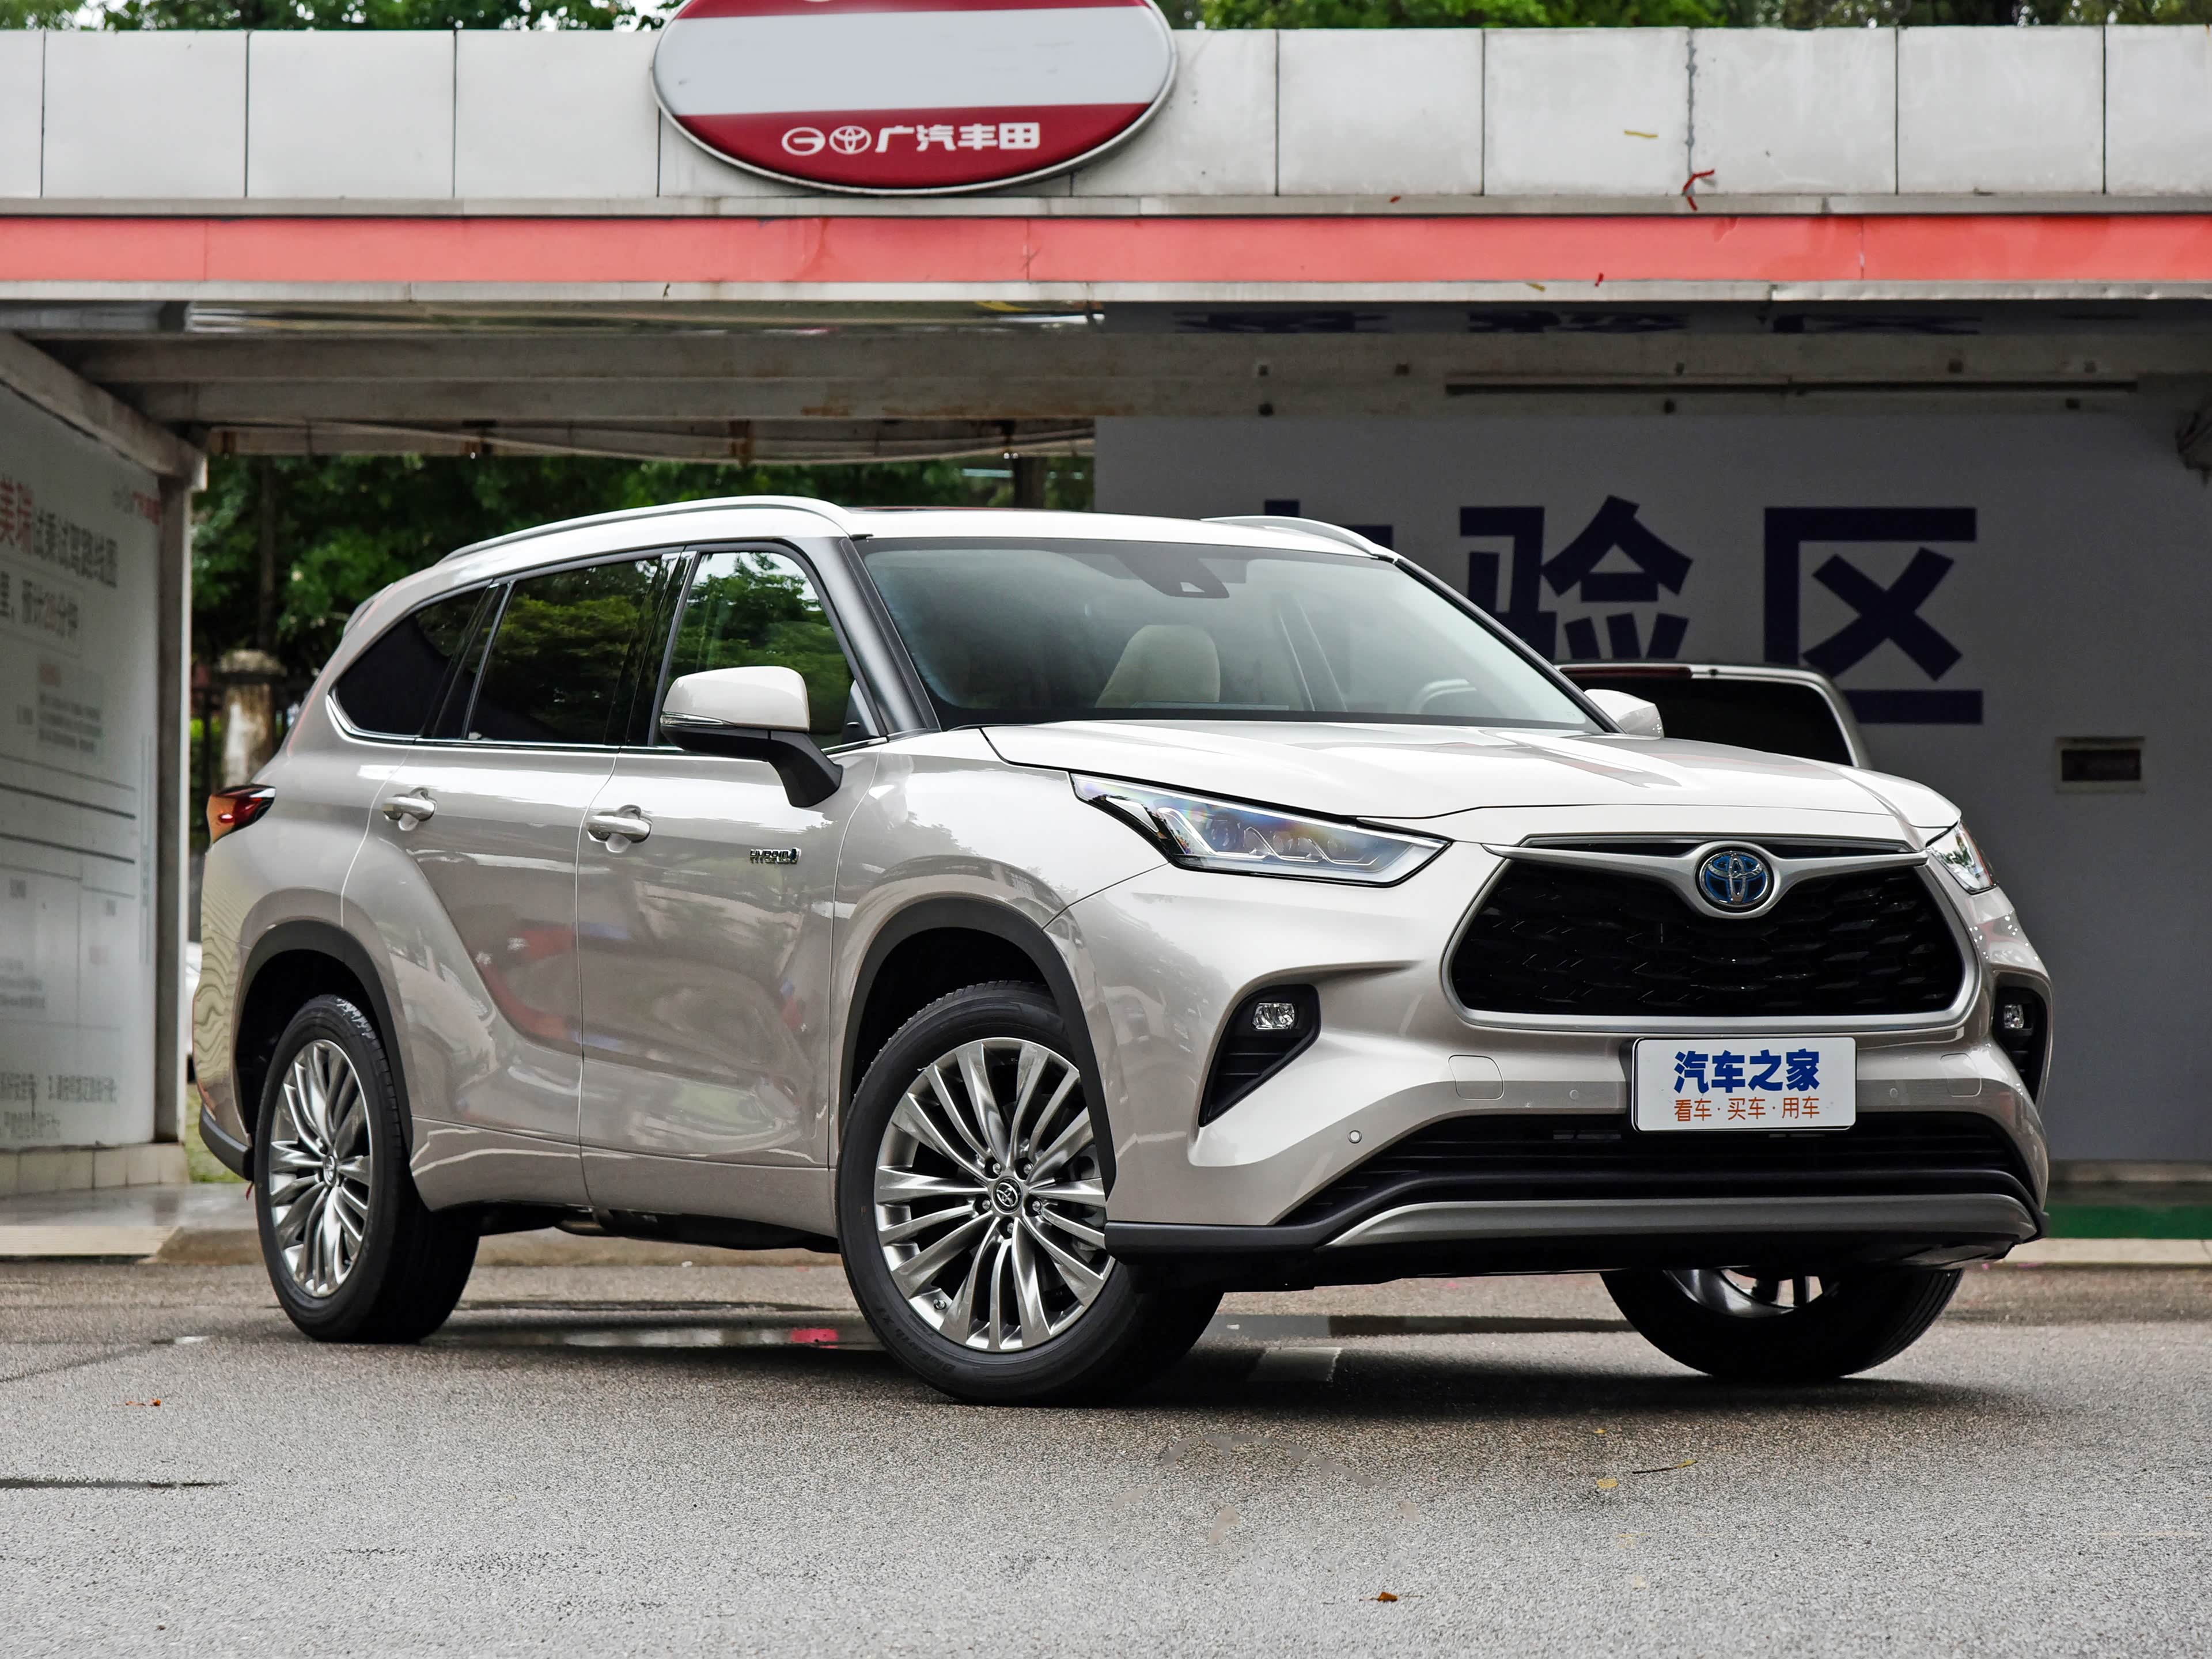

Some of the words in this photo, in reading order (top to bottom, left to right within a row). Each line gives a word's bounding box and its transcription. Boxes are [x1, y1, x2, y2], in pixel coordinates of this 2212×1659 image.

[875, 122, 1040, 153] 广汽丰田
[1264, 495, 1983, 724] 验区
[1673, 1048, 1820, 1094] 汽车之家
